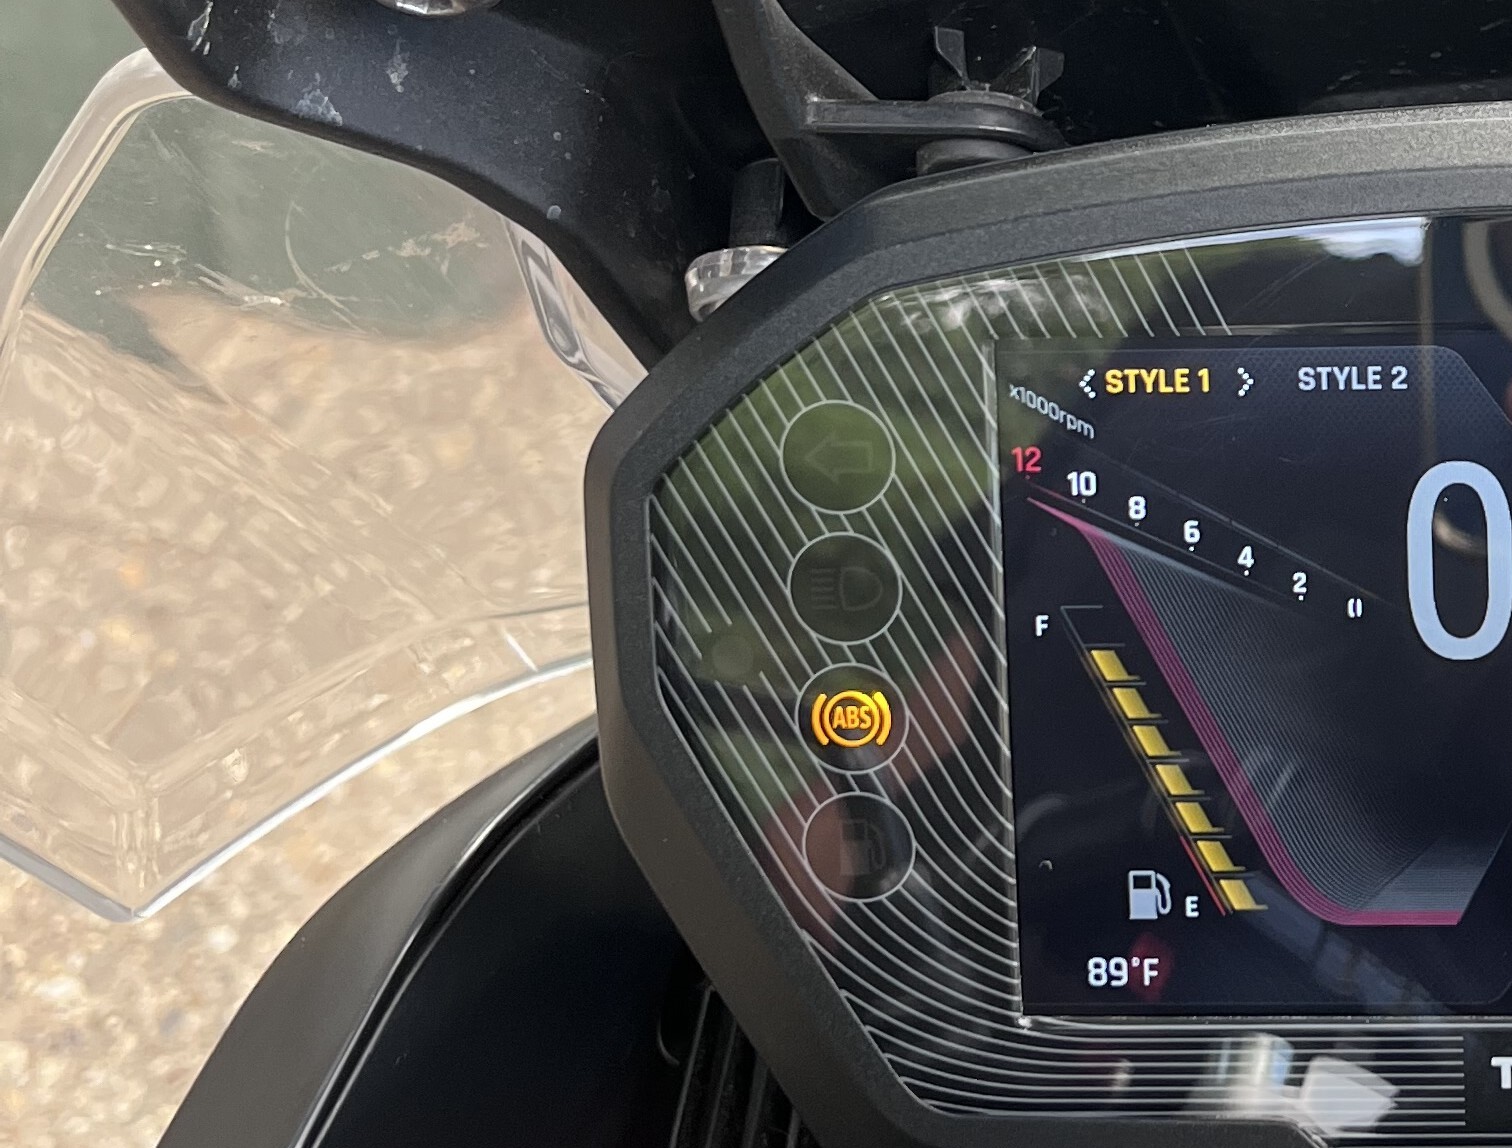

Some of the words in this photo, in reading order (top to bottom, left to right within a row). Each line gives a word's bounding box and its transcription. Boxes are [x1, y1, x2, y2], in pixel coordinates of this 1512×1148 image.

[1105, 368, 1190, 394] STYLE
[1198, 368, 1211, 393] 1
[1298, 366, 1382, 391] STYLE
[1391, 366, 1409, 390] 2
[1009, 384, 1095, 440] x1000rpm
[1011, 446, 1042, 473] 12
[1067, 471, 1097, 496] 10
[1127, 495, 1147, 520] 8
[1183, 520, 1201, 544] 6
[1237, 545, 1255, 569] 4
[1292, 571, 1308, 594] 2
[1034, 614, 1049, 637] F
[832, 705, 871, 730] ABS
[1185, 895, 1199, 919] E
